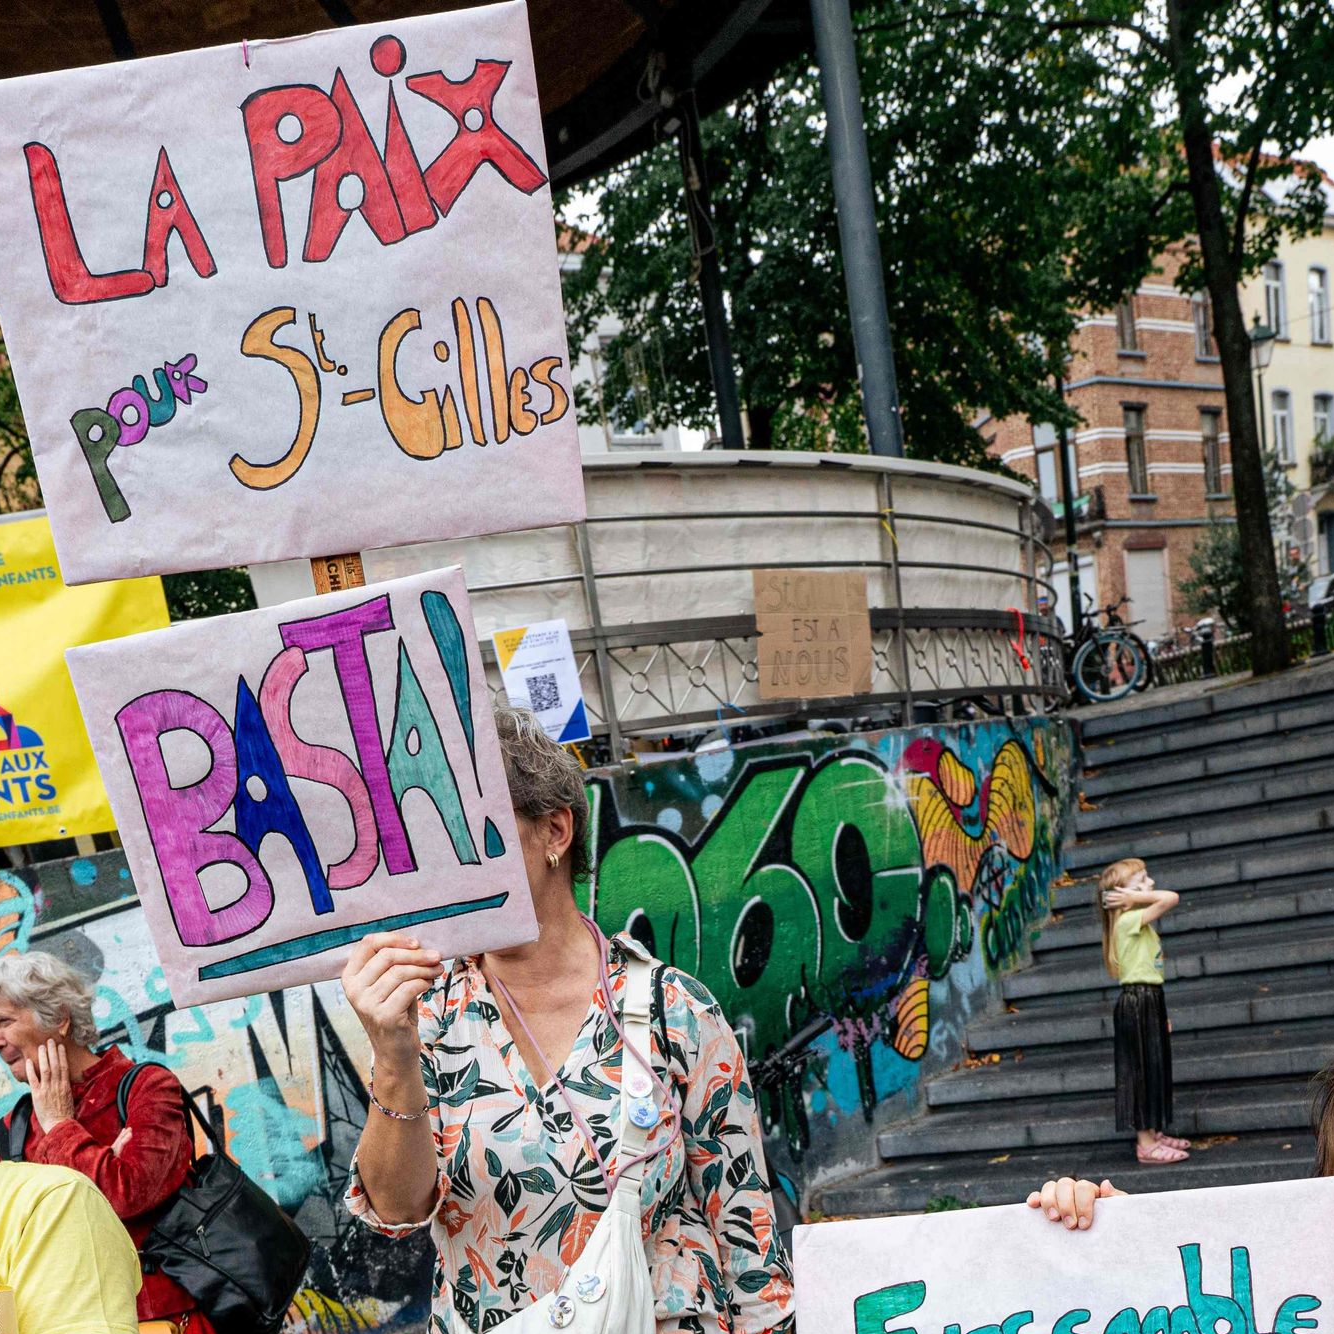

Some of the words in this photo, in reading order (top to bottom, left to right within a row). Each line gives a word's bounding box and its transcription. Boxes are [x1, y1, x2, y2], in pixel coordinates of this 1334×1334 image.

[23, 142, 217, 304] LA
[792, 618, 819, 643] EST
[771, 646, 851, 686] NOUS
[1, 751, 49, 774] AUX
[115, 591, 506, 947] BASTA!
